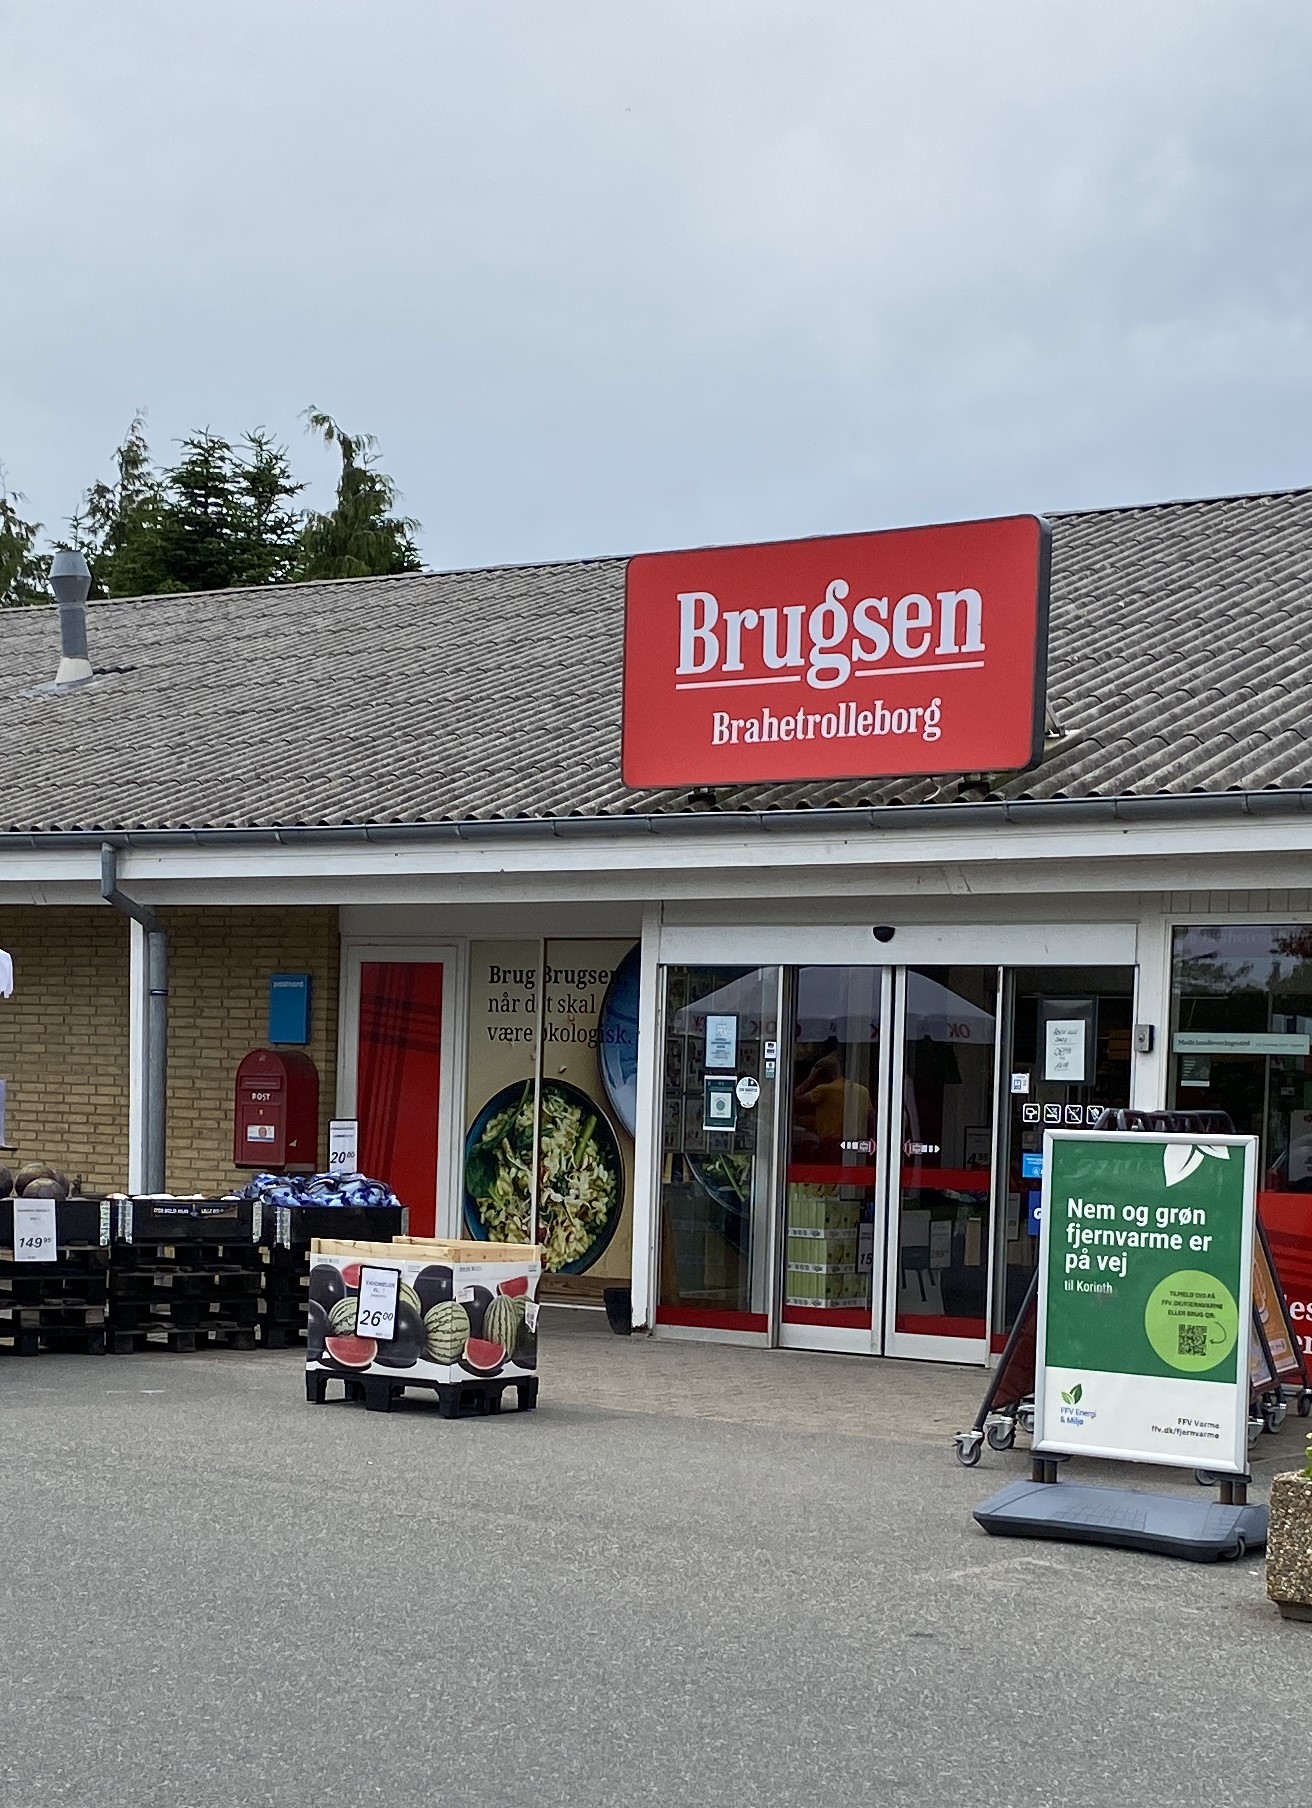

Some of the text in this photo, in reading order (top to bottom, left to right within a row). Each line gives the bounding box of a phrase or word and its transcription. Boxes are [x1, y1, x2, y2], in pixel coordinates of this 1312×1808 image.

[675, 578, 986, 690] Brugsen
[711, 697, 943, 746] Brahetrolleborg
[273, 980, 304, 989] postnord
[488, 965, 536, 990] Brug
[488, 991, 596, 1014] når dt skal
[487, 1026, 533, 1042] være
[251, 1092, 271, 1101] POST
[1067, 1198, 1206, 1228] Nem og grøn
[1066, 1223, 1213, 1252] fjernvarme er
[1065, 1248, 1128, 1277] på vej
[1064, 1280, 1113, 1294] til Korinth
[1060, 1407, 1097, 1419] FFV Energi
[1060, 1416, 1066, 1424] &
[1177, 1417, 1220, 1429] FFV Varme
